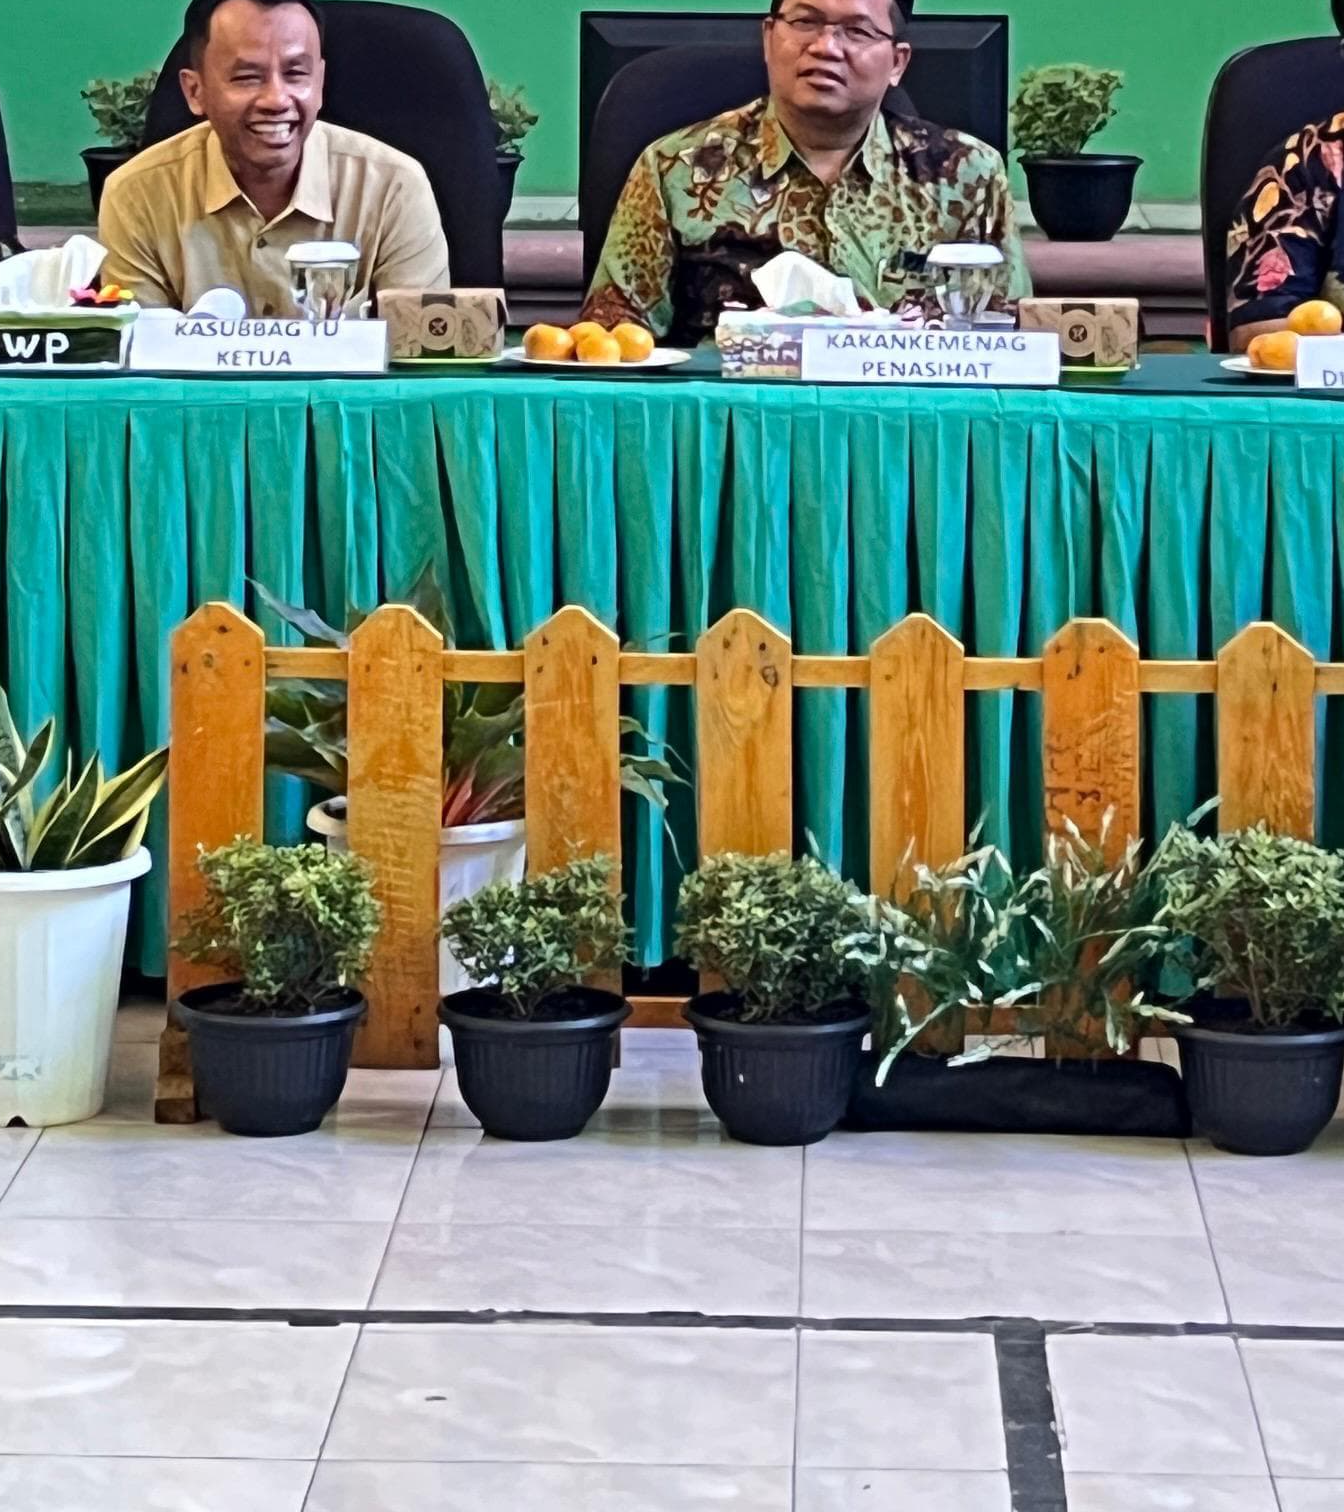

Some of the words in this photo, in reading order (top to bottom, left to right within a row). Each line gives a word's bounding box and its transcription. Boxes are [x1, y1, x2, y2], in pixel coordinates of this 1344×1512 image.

[827, 334, 1026, 351] KAKANKEMENAG
[217, 350, 292, 366] KETUA
[862, 362, 992, 378] PENASIHAT
